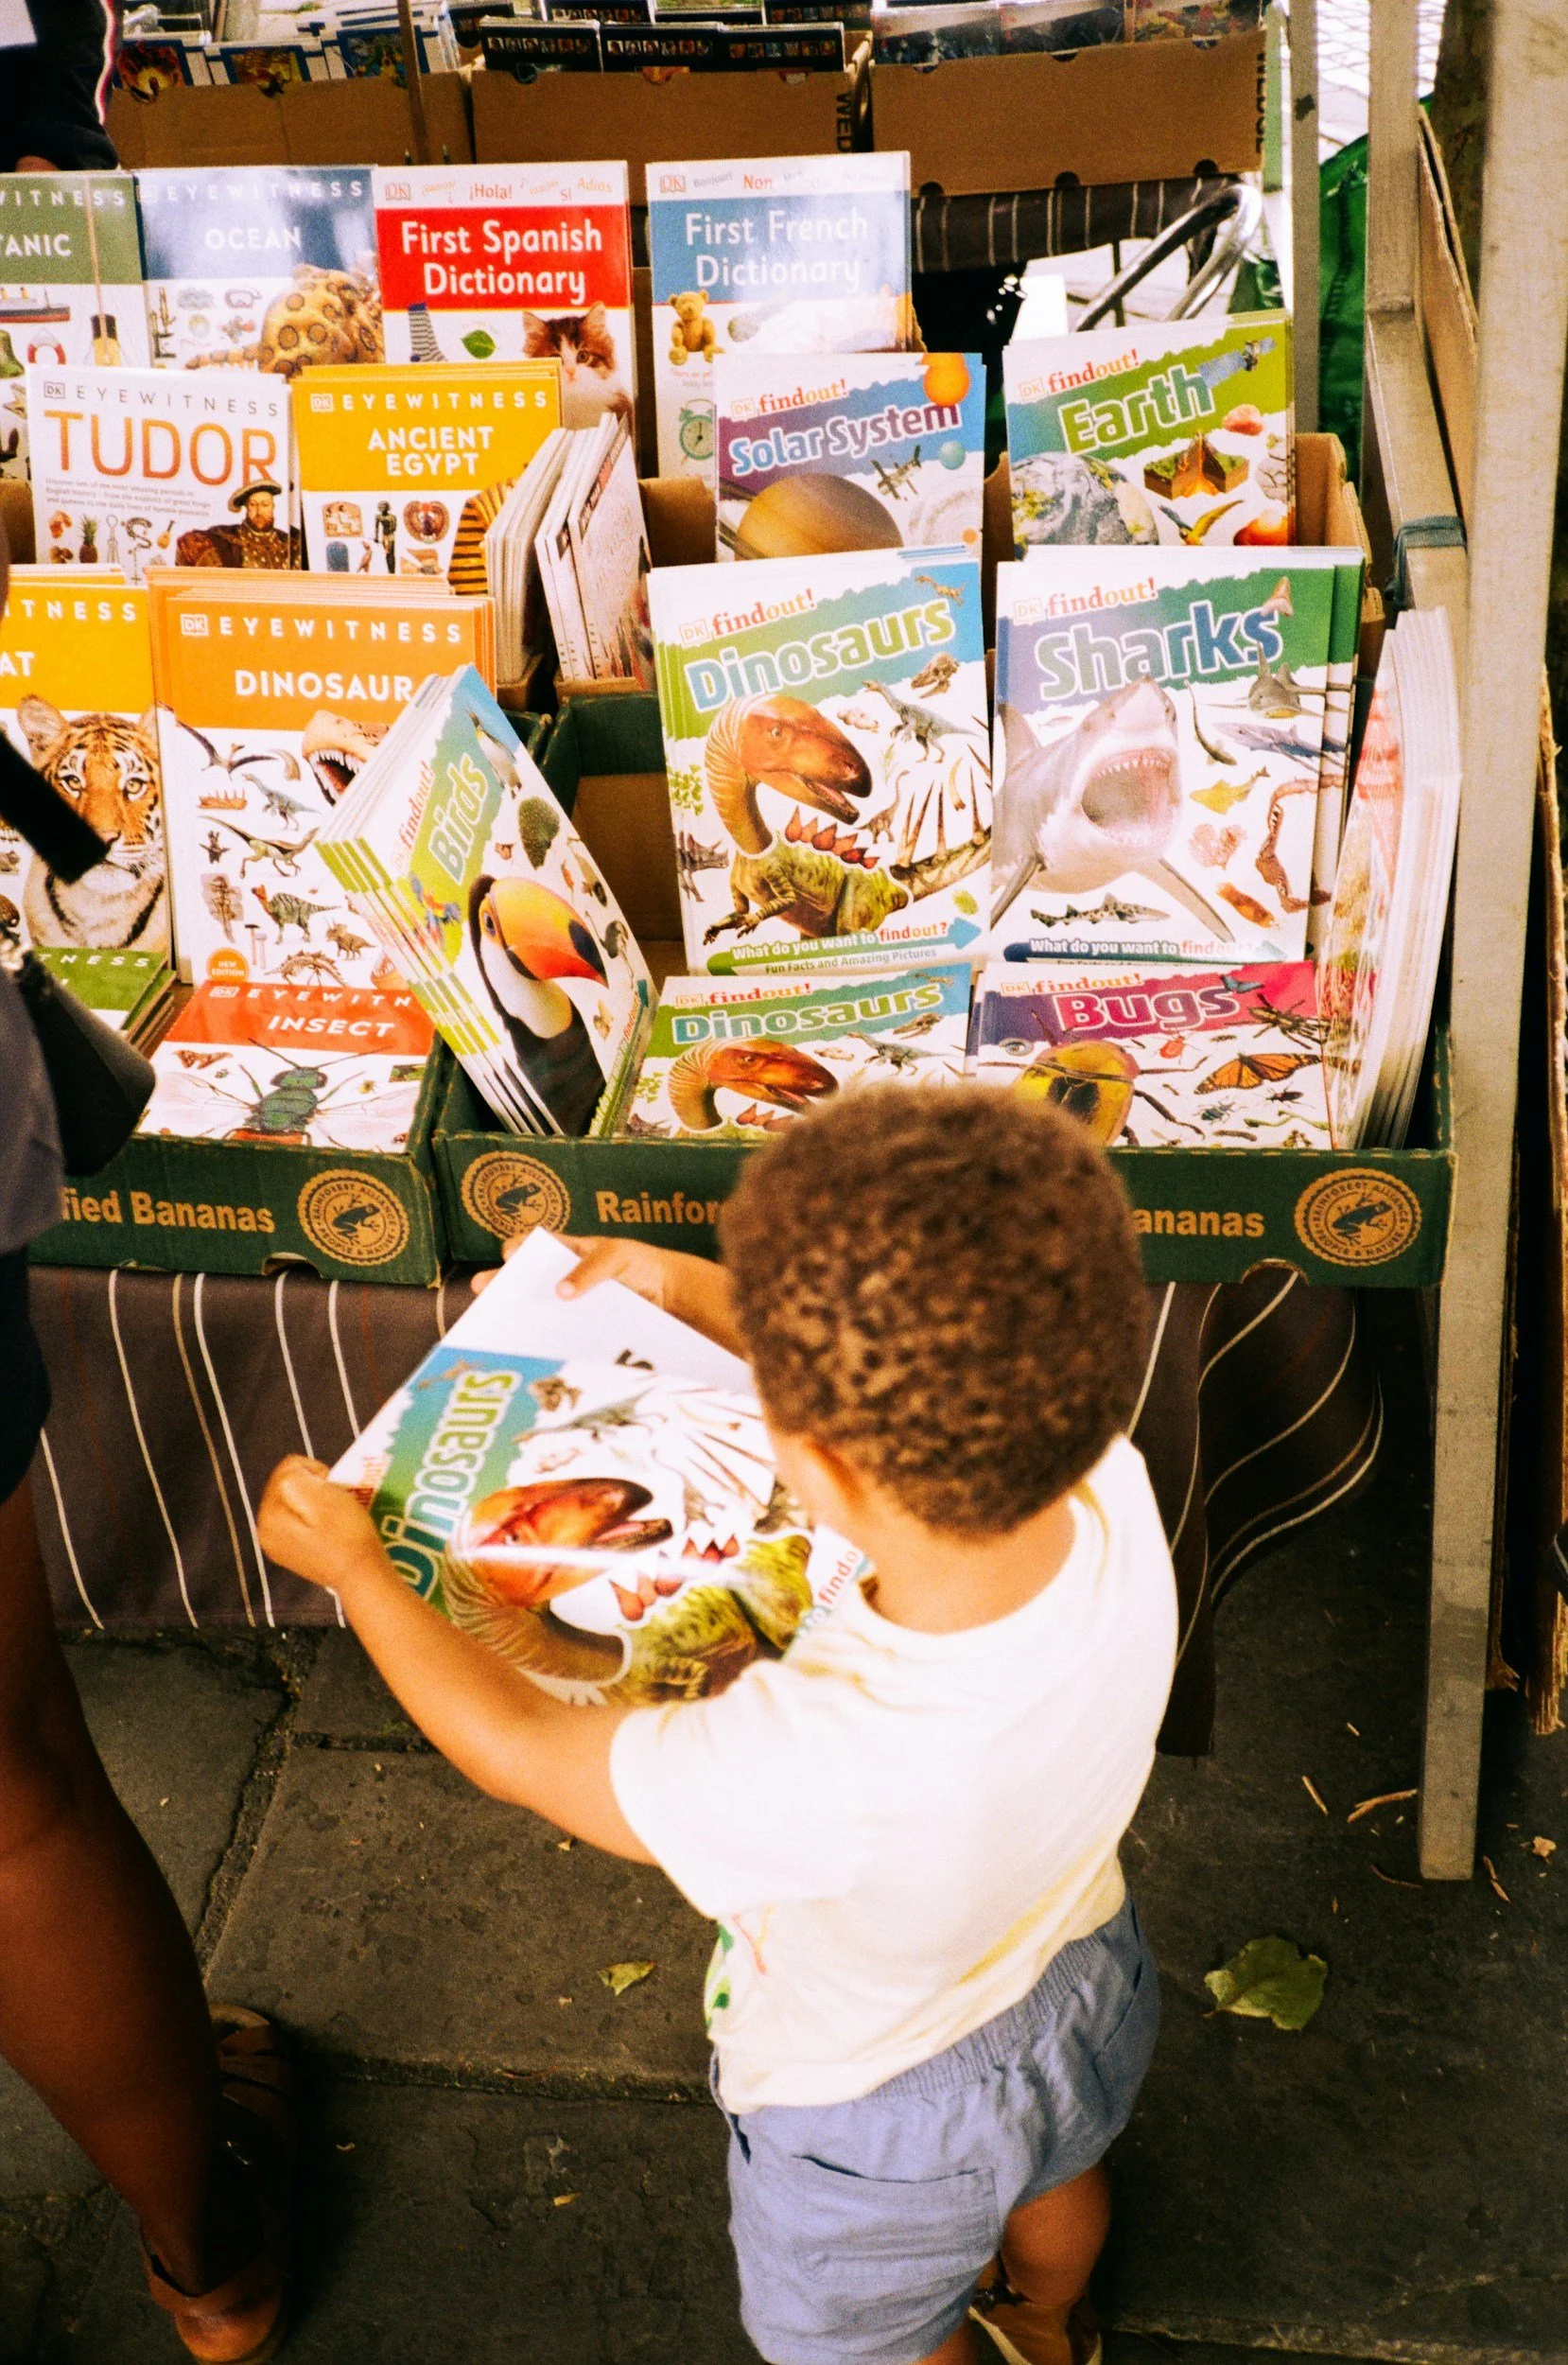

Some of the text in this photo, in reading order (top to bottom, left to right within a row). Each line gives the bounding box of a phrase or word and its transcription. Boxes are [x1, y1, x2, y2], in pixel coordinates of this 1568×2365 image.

[166, 181, 363, 201] EYEWITNESS
[386, 184, 410, 201] DK
[470, 183, 513, 201] ¡Hola!
[661, 176, 685, 192] DK
[743, 174, 773, 189] Non
[205, 226, 302, 251] OCEAN
[402, 219, 603, 265] First Spanish
[686, 207, 868, 246] First French
[0, 234, 72, 257] ANIC
[424, 262, 586, 306] Dictionary
[696, 254, 862, 295] Dictionary
[1048, 349, 1140, 394] findout!
[45, 384, 64, 397] DK
[77, 385, 278, 417] EYEWITNESS
[312, 395, 332, 411] DK
[342, 392, 548, 411] EYEWITNESS
[758, 379, 849, 413] findout!
[1057, 364, 1217, 455] Earth
[44, 410, 277, 487] TUDOR
[368, 426, 494, 451] ANCIENT
[730, 404, 961, 476] Solar System
[386, 452, 479, 476] EGYPT
[712, 589, 816, 636] findout!
[1048, 577, 1158, 618] findout!
[183, 615, 206, 634] DK
[219, 616, 462, 644] EYEWITNESS
[684, 599, 956, 712] Dinosaurs
[1035, 601, 1283, 702] Sharks
[235, 669, 413, 702] DINOSAUR
[428, 752, 488, 886] Birds
[731, 921, 948, 960] What do you want to findout?
[1029, 937, 1068, 954] What
[1070, 938, 1089, 954] do
[1091, 941, 1120, 956] you
[1121, 939, 1159, 955] want
[1160, 940, 1179, 955] to
[211, 968, 245, 977] EDITION
[765, 947, 936, 974] Fun Facts and Amazing Pictures
[709, 982, 812, 1005] findout!
[1003, 973, 1145, 994] DK findout!
[268, 1015, 395, 1037] INSECT
[671, 982, 944, 1044] Dinosaurs
[1052, 987, 1241, 1033] Bugs
[130, 1190, 276, 1234] Bananas
[380, 1371, 522, 1600] Dinosaurs
